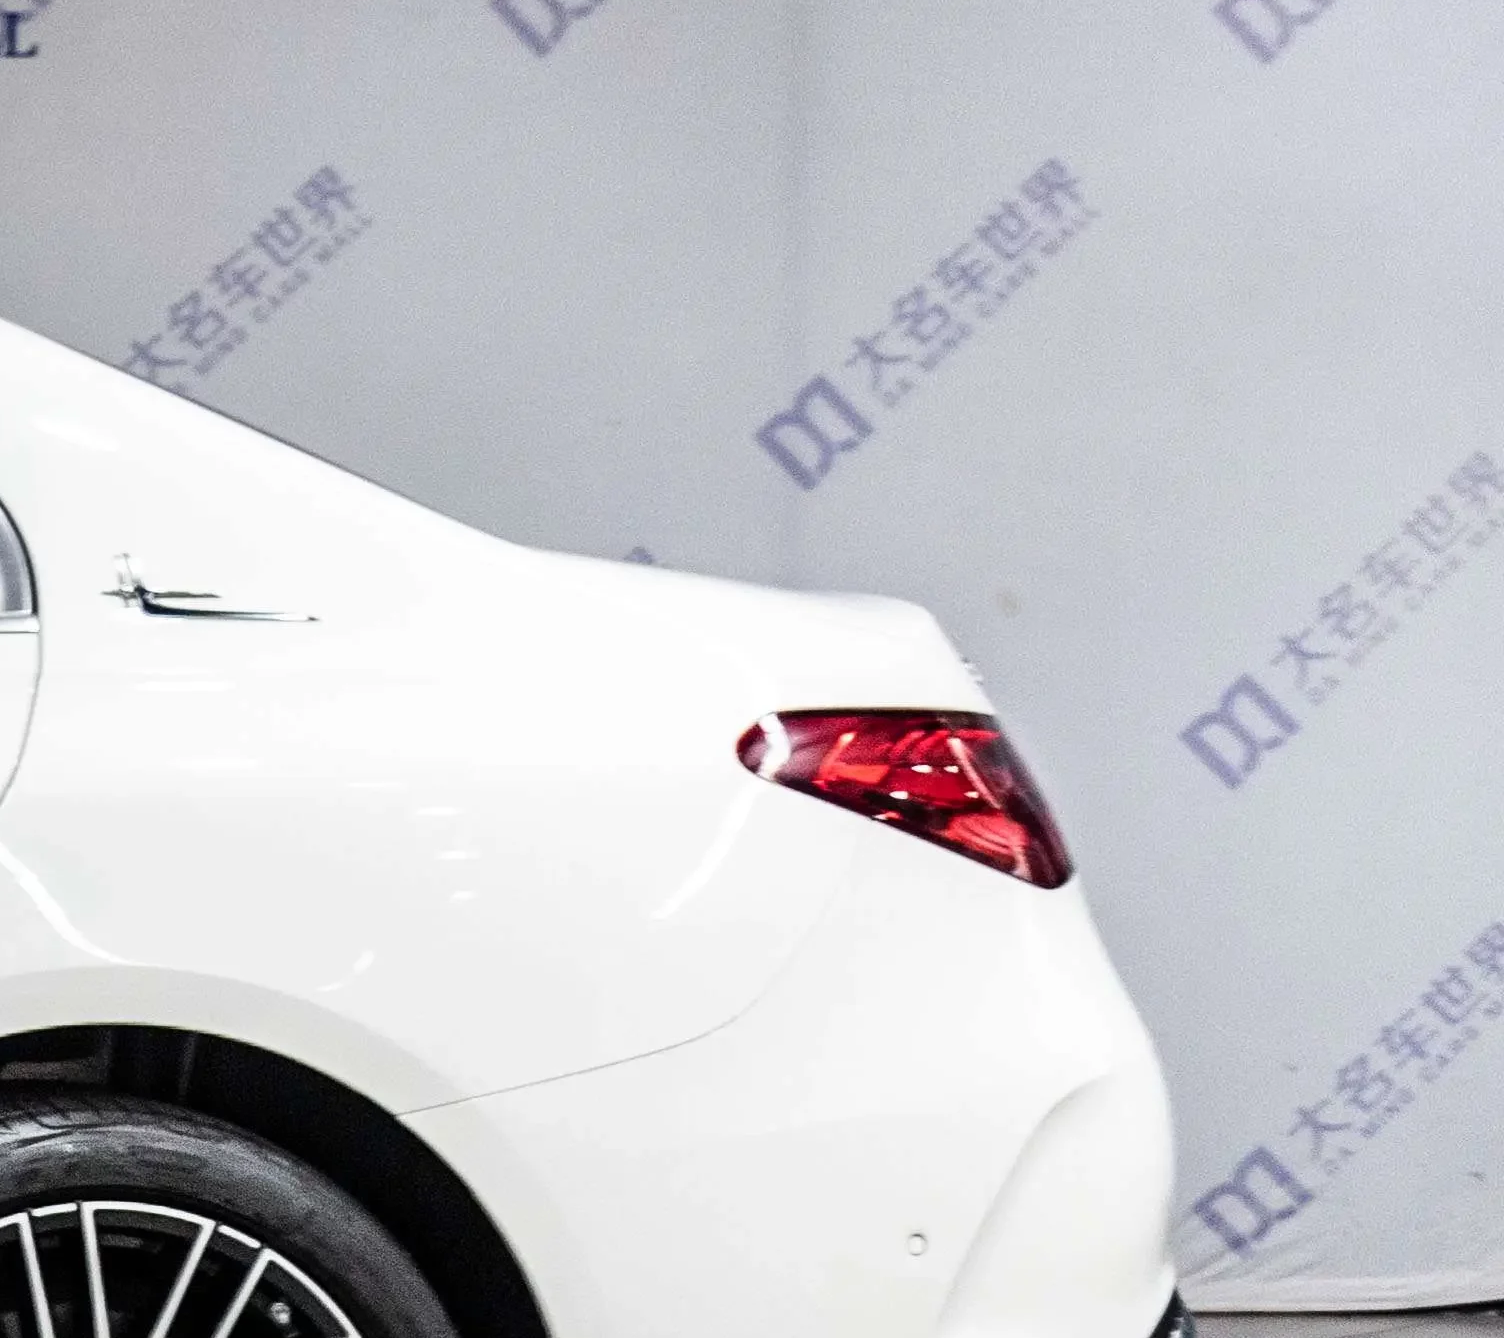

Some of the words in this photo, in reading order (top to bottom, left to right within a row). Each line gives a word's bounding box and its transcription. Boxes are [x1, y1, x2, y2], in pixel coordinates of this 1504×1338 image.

[123, 166, 356, 379] 大名车世界
[845, 159, 1081, 390] 大名车世界
